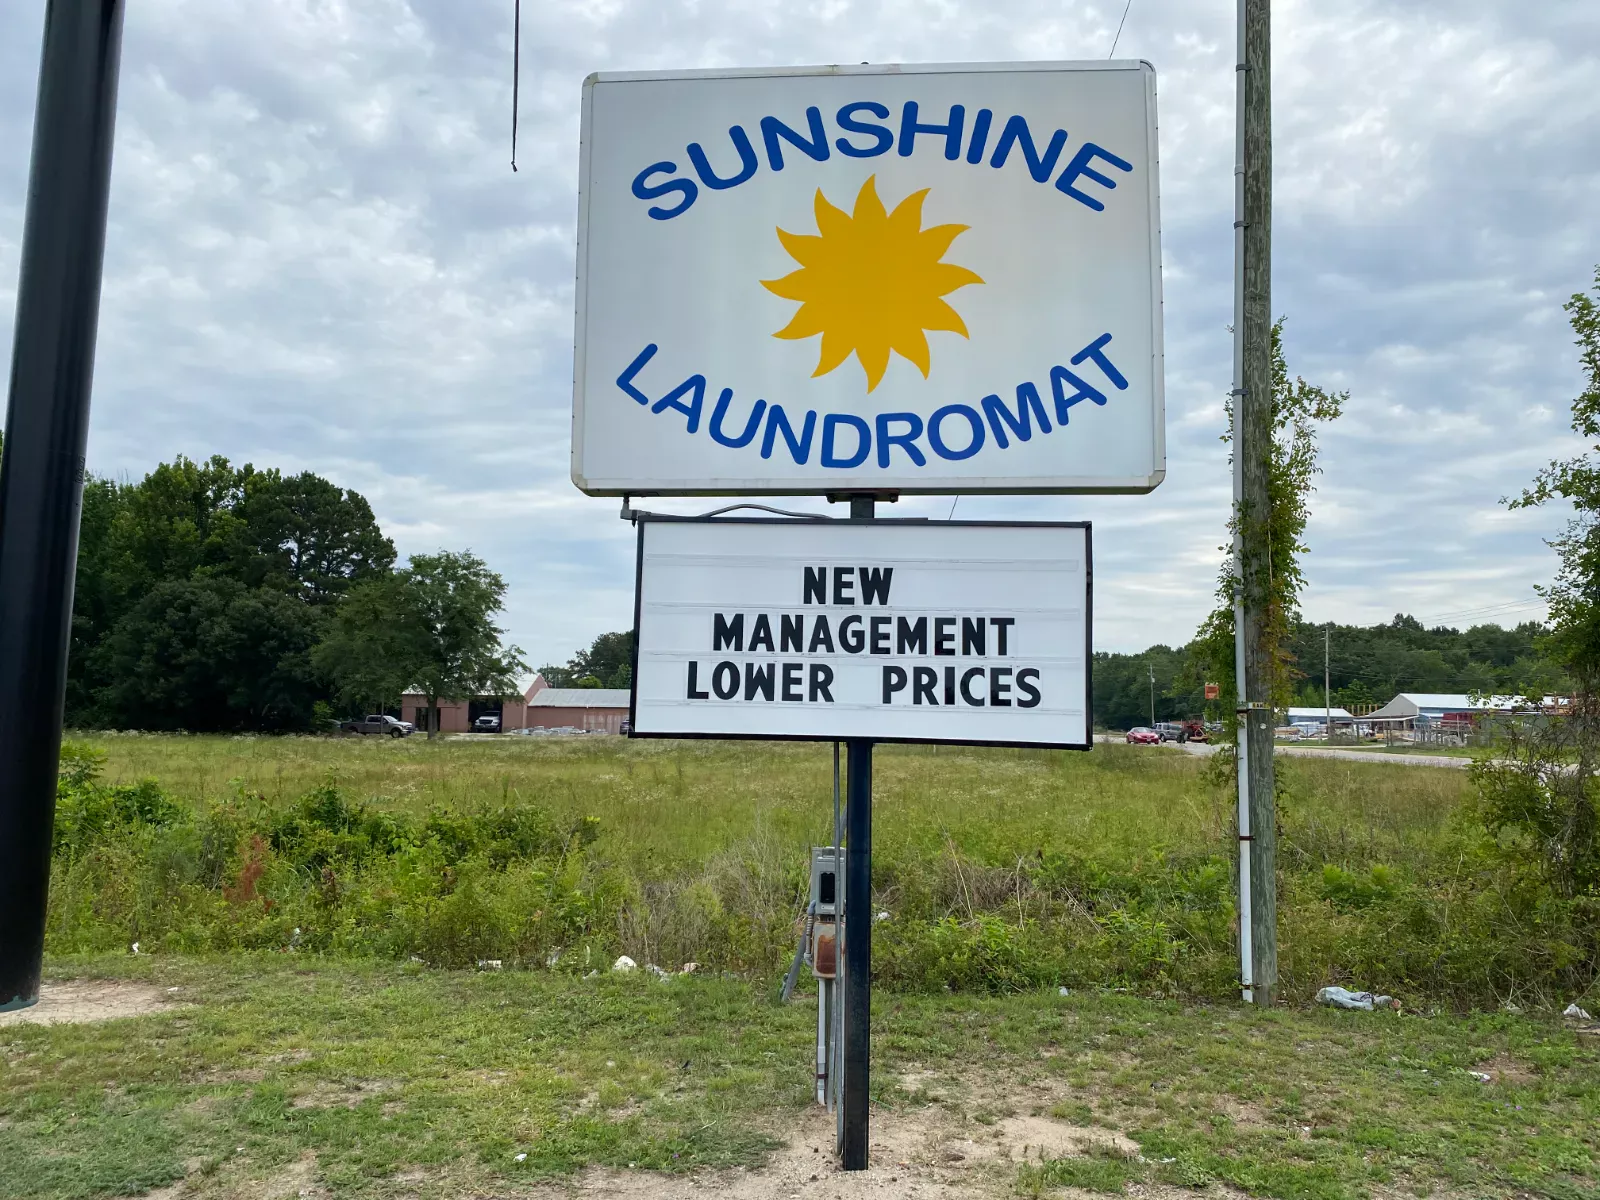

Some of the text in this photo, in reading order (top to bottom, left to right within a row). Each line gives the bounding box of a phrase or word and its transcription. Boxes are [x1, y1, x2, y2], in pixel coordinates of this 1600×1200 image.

[632, 101, 1132, 220] SUNSHINE
[616, 333, 1128, 468] LAUNDROMAT
[803, 566, 894, 606] NEW
[713, 613, 1015, 656] MANAGEMENT
[687, 661, 1041, 708] LOWER PRICES
